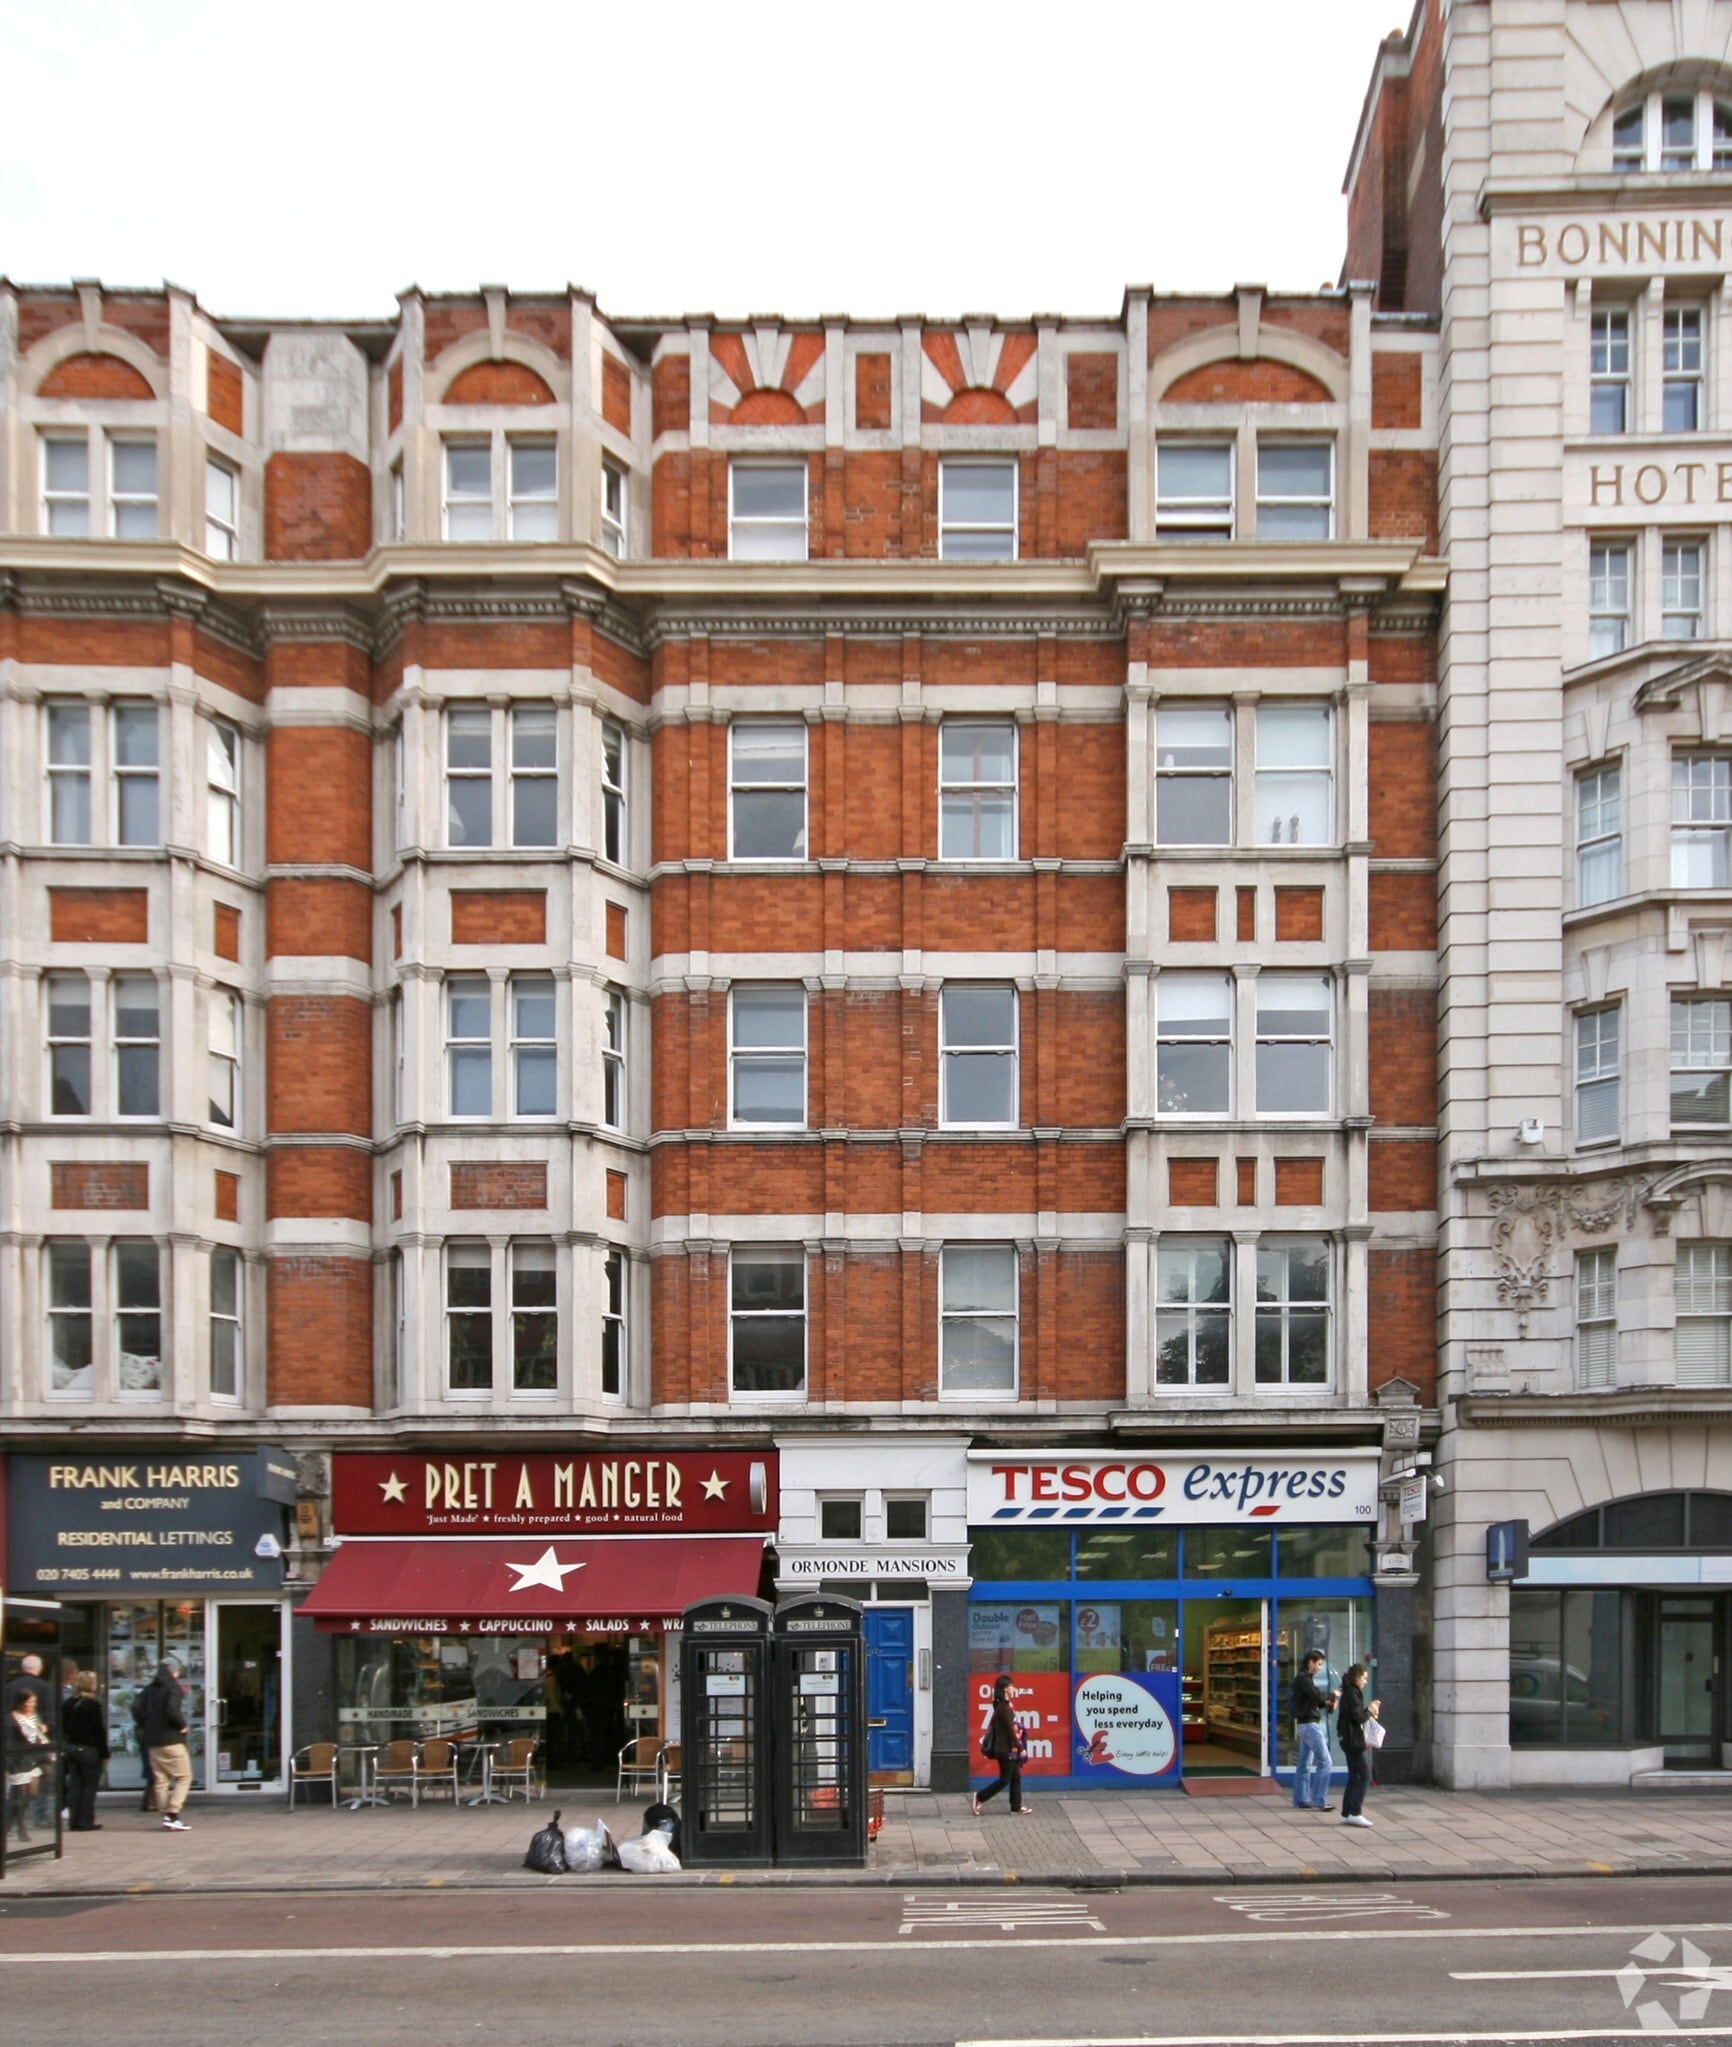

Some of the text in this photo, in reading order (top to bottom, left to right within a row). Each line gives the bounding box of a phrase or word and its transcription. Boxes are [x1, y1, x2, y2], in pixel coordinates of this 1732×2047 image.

[1517, 218, 1732, 267] BONNIN
[1590, 462, 1732, 506] HOTE
[50, 1465, 139, 1488] FRANK
[147, 1464, 240, 1488] HARRIS
[425, 1461, 683, 1509] PRET A MANGER
[991, 1463, 1347, 1511] TESCO express
[100, 1497, 191, 1510] and COMPANY
[1355, 1505, 1371, 1515] 100
[494, 1513, 525, 1525] freshly
[528, 1513, 570, 1525] prepared
[585, 1513, 609, 1525] good
[624, 1513, 658, 1522] natural
[661, 1512, 683, 1522] food
[57, 1531, 233, 1546] RESIDENTIAL LETTINGS
[791, 1559, 956, 1573] ORMONDE MANSIONS
[36, 1568, 60, 1581] 020
[129, 1568, 254, 1580] www.frankharris.co.uk
[370, 1619, 448, 1632] SANDWICHES
[479, 1619, 553, 1632] CAPPUCCINO
[585, 1619, 629, 1632] SALADS
[710, 1621, 758, 1631] TELEPHONE
[801, 1620, 851, 1630] TELEPHONE
[979, 1684, 1019, 1701] On
[1082, 1691, 1122, 1702] Helping
[367, 1708, 520, 1719] HANDMADE SANDWICHES
[978, 1703, 1040, 1729] 7m
[1086, 1704, 1138, 1716] you spend
[1094, 1718, 1163, 1730] less everyday
